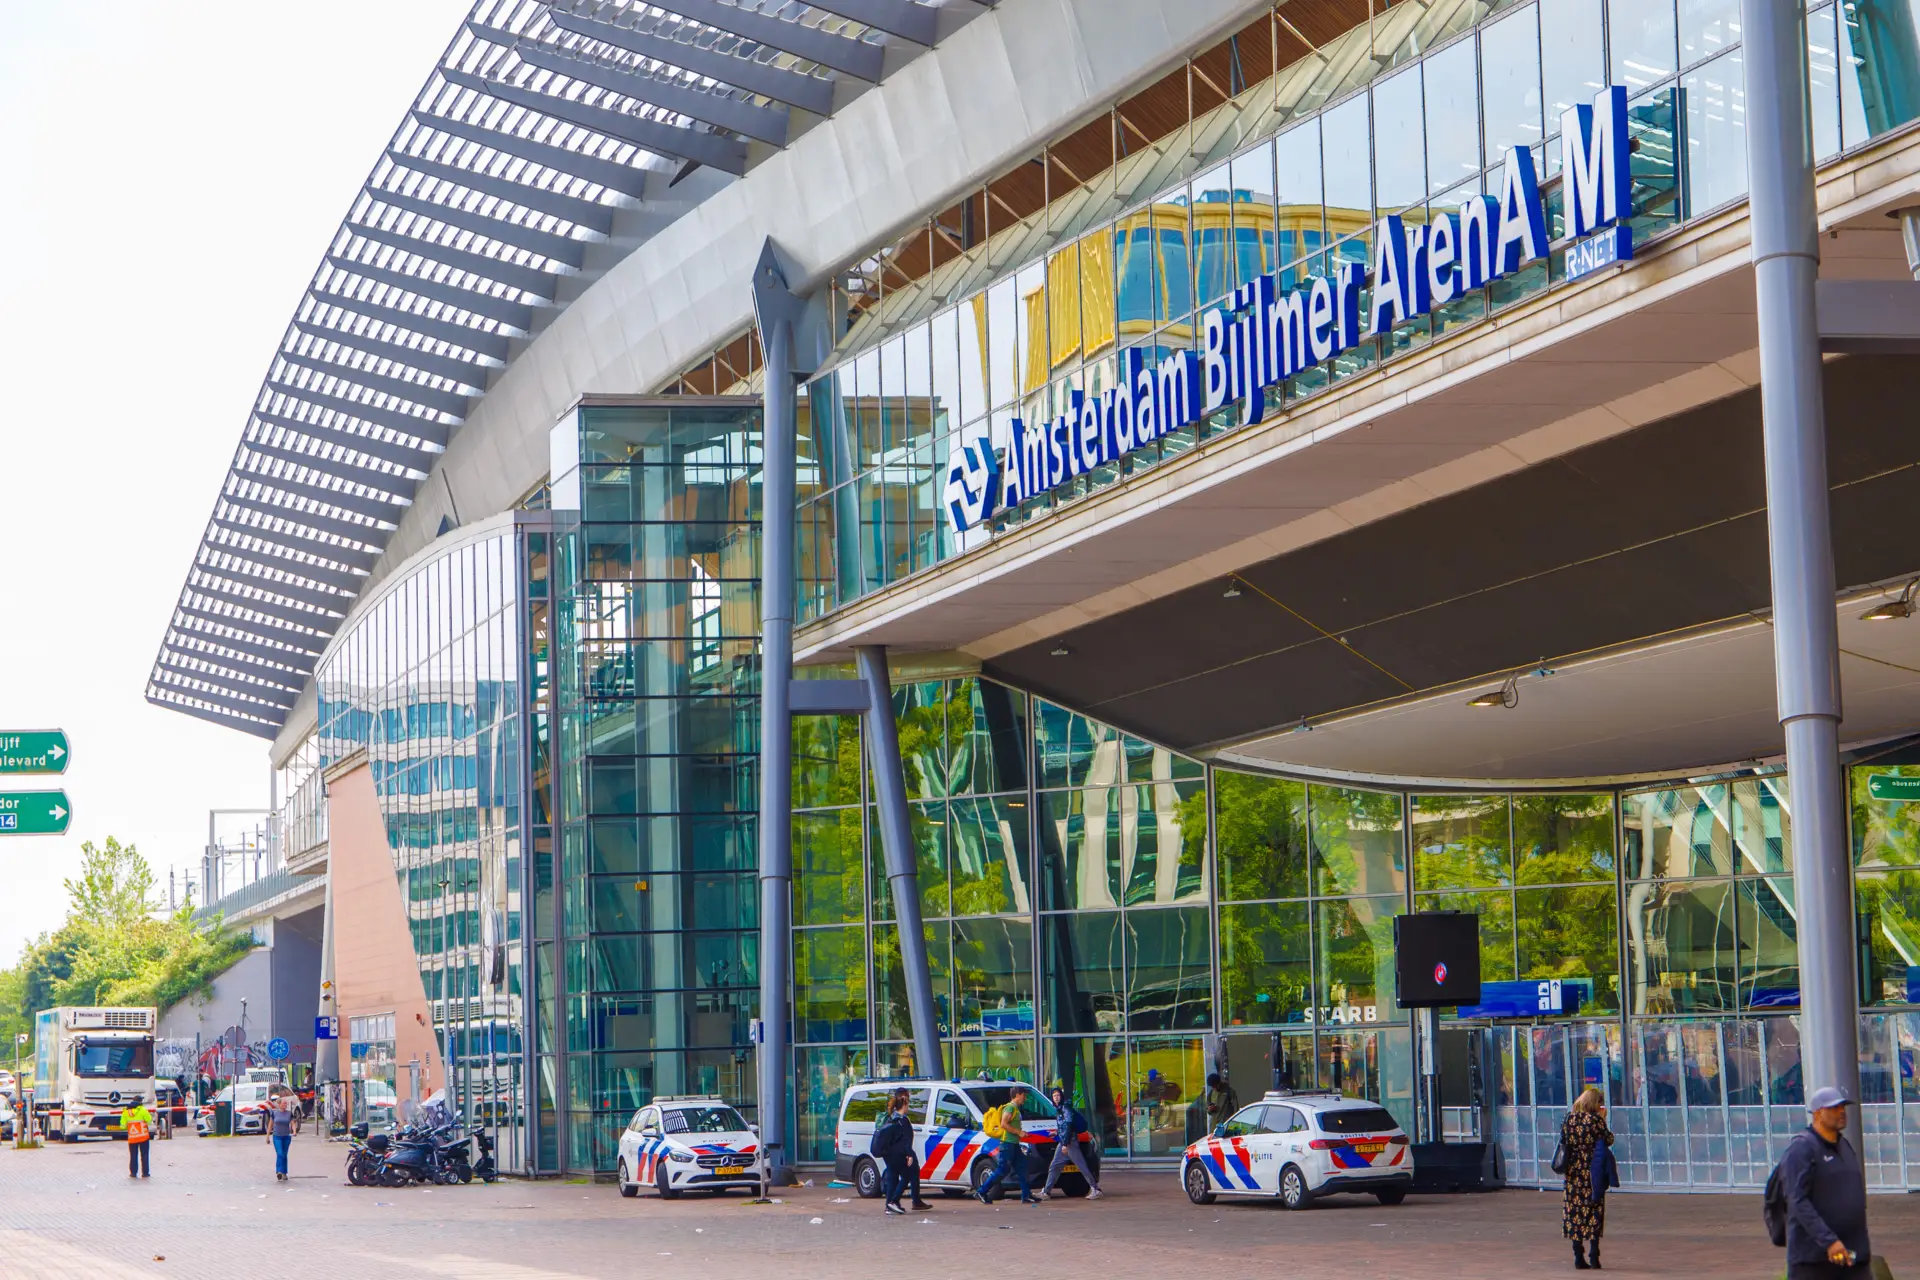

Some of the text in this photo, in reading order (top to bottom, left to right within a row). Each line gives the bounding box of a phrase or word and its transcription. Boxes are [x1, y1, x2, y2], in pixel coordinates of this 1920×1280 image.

[1560, 85, 1628, 242] M
[1002, 146, 1548, 508] Amsterdam Bijlmer ArenA
[1304, 1005, 1377, 1022] STARB
